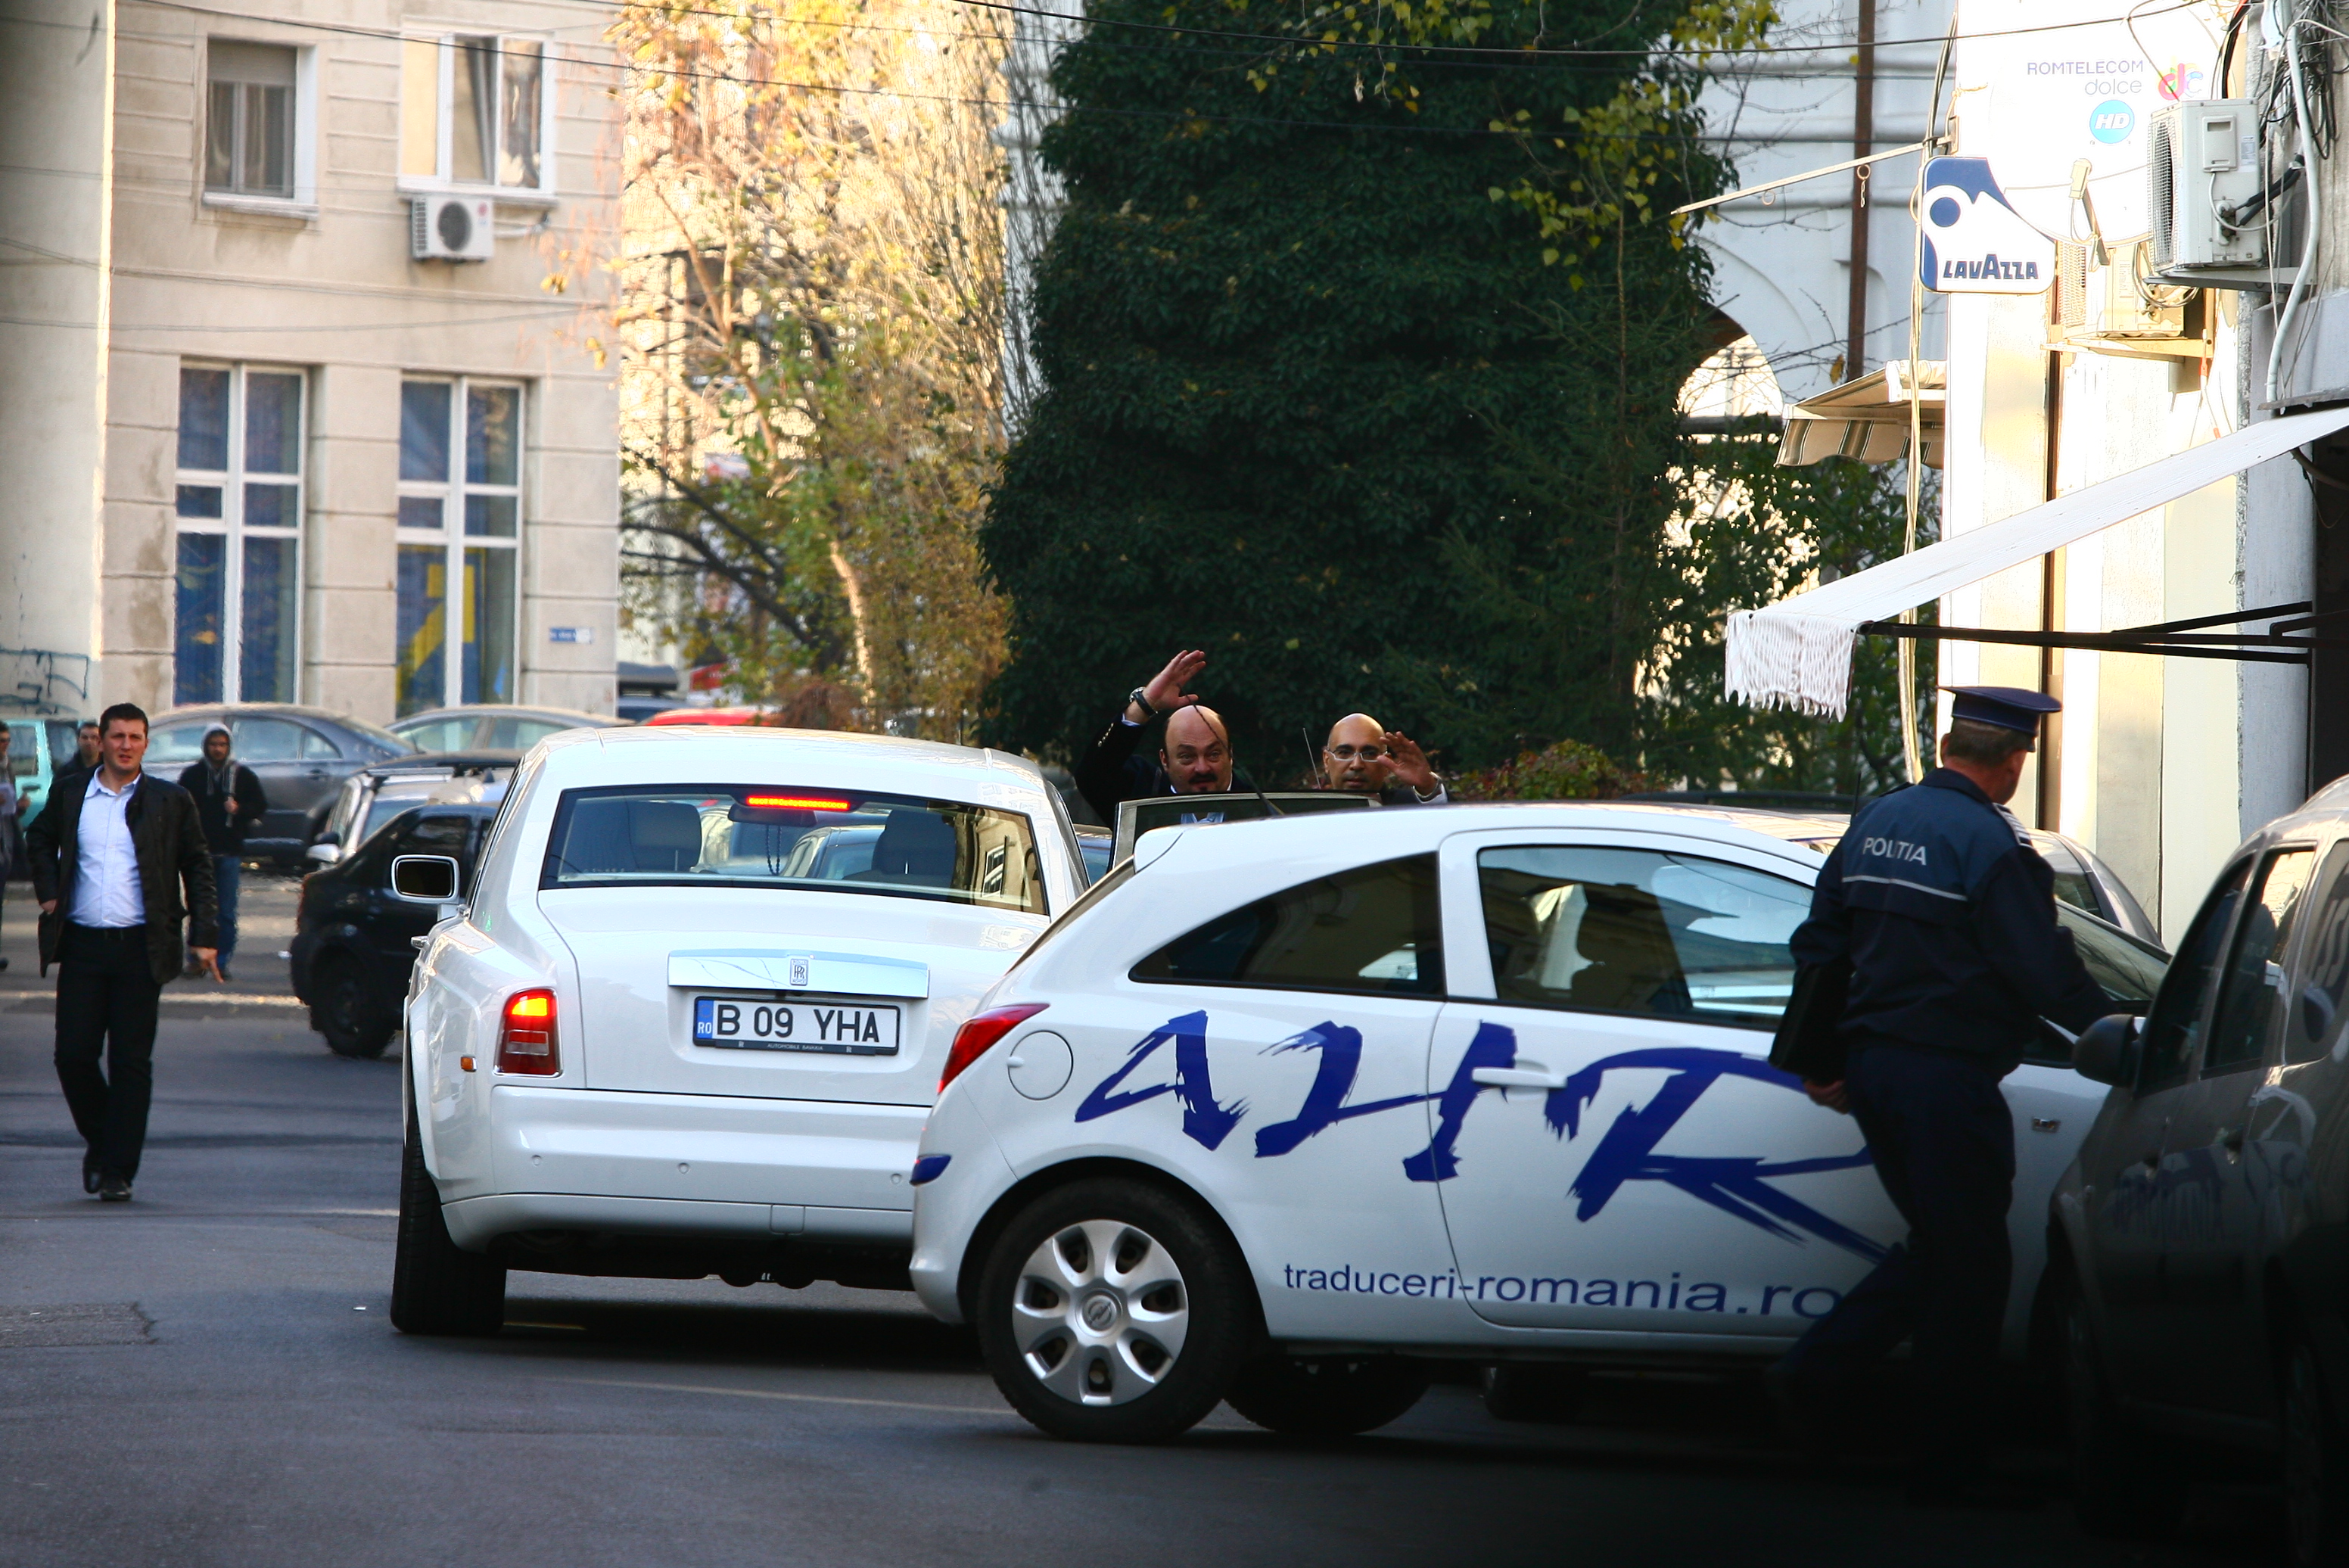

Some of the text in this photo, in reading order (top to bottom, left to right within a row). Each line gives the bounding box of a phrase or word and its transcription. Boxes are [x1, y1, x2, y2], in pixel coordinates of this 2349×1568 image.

[2027, 60, 2143, 75] ROMTELECOM
[2084, 78, 2142, 95] dolce
[2094, 113, 2131, 129] HD
[1943, 254, 2039, 279] LAVAZZA
[1862, 836, 1927, 866] POLTIA
[697, 1022, 712, 1034] RO
[717, 1004, 880, 1042] B 09 YHA
[1284, 1263, 1844, 1320] traduceri-romania.ro
